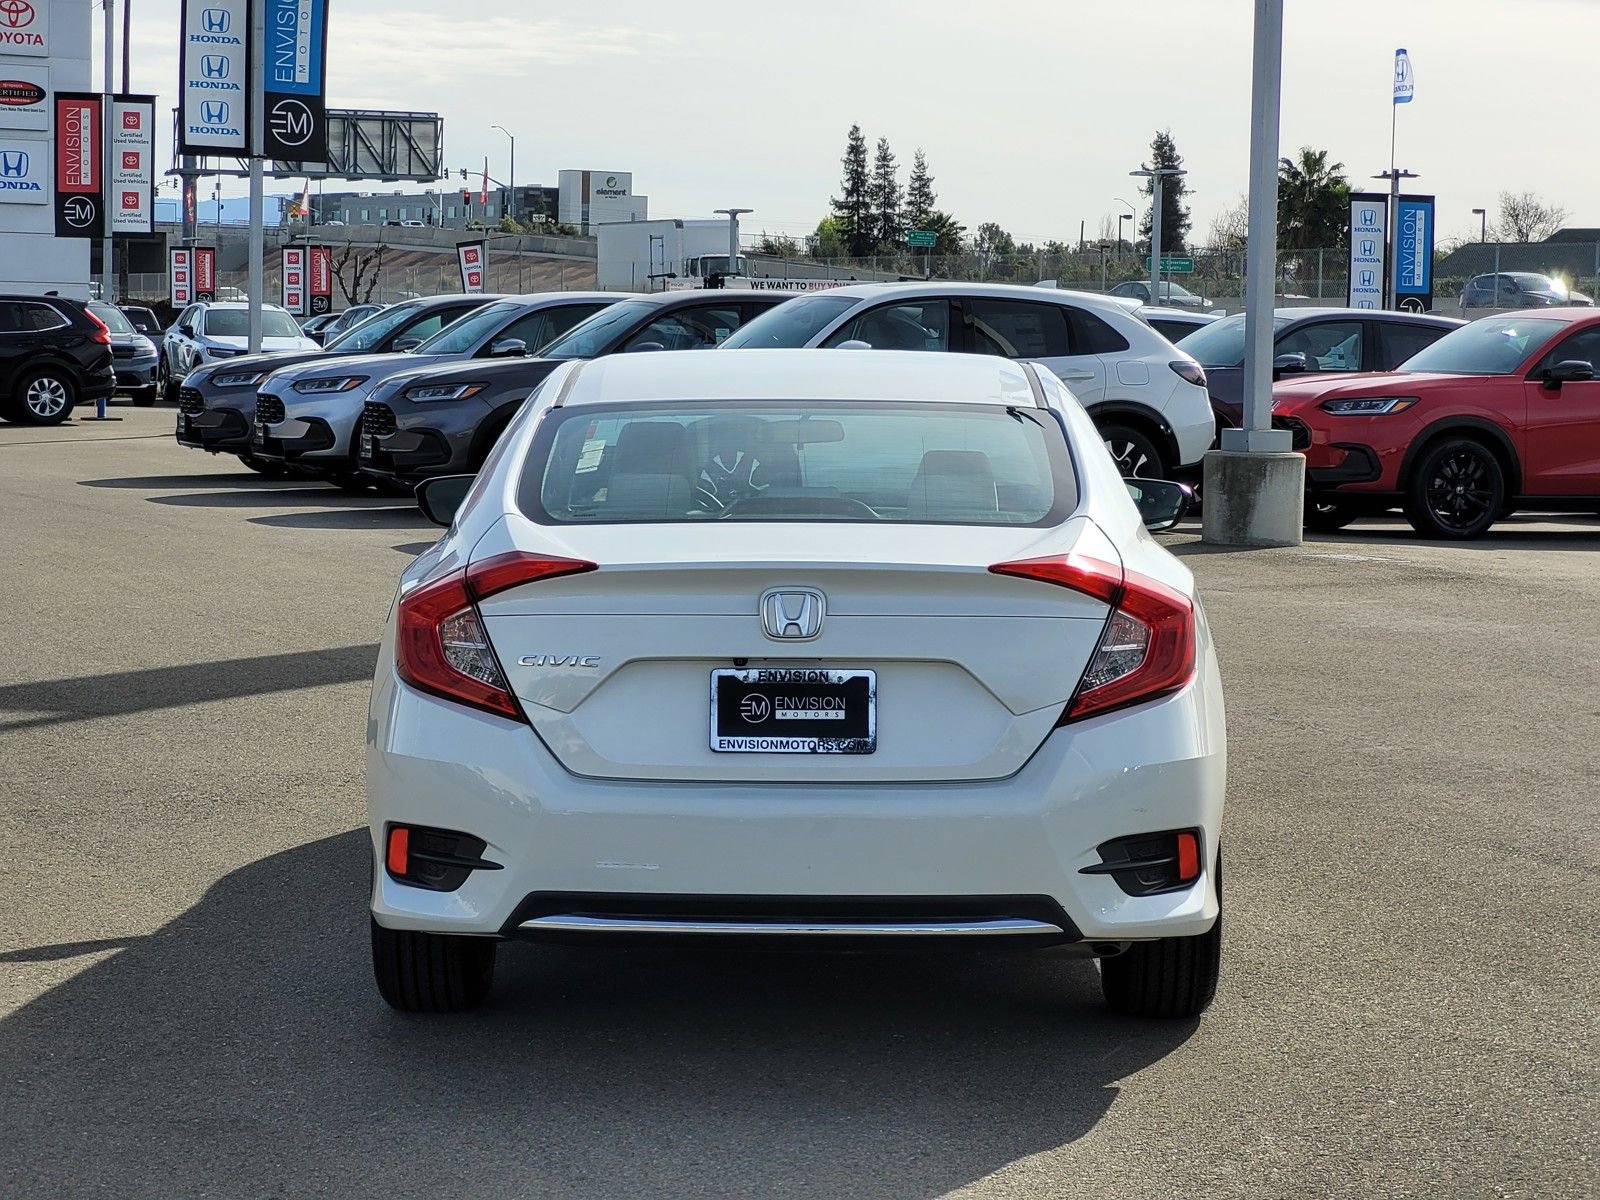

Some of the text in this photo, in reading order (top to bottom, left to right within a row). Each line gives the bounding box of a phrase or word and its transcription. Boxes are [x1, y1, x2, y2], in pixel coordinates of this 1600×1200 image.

[0, 32, 44, 46] YOTA
[190, 35, 241, 44] HONDA
[275, 0, 297, 82] ENVISI
[298, 0, 309, 73] MOTO
[189, 81, 241, 90] HONDA
[189, 126, 240, 135] HONDA
[66, 107, 80, 185] ENVISION
[596, 188, 626, 196] element
[1401, 209, 1416, 287] ENVISION
[198, 253, 206, 289] ENVISION
[313, 252, 321, 292] ENVISION
[750, 281, 765, 290] WE
[766, 281, 792, 290] WANT
[795, 282, 807, 290] TO
[808, 282, 826, 290] BUY
[517, 655, 601, 668] CIVIC
[758, 671, 829, 682] ENVISION
[775, 696, 846, 709] ENVISION
[719, 739, 867, 750] ENVISIONMOTORS.COM
